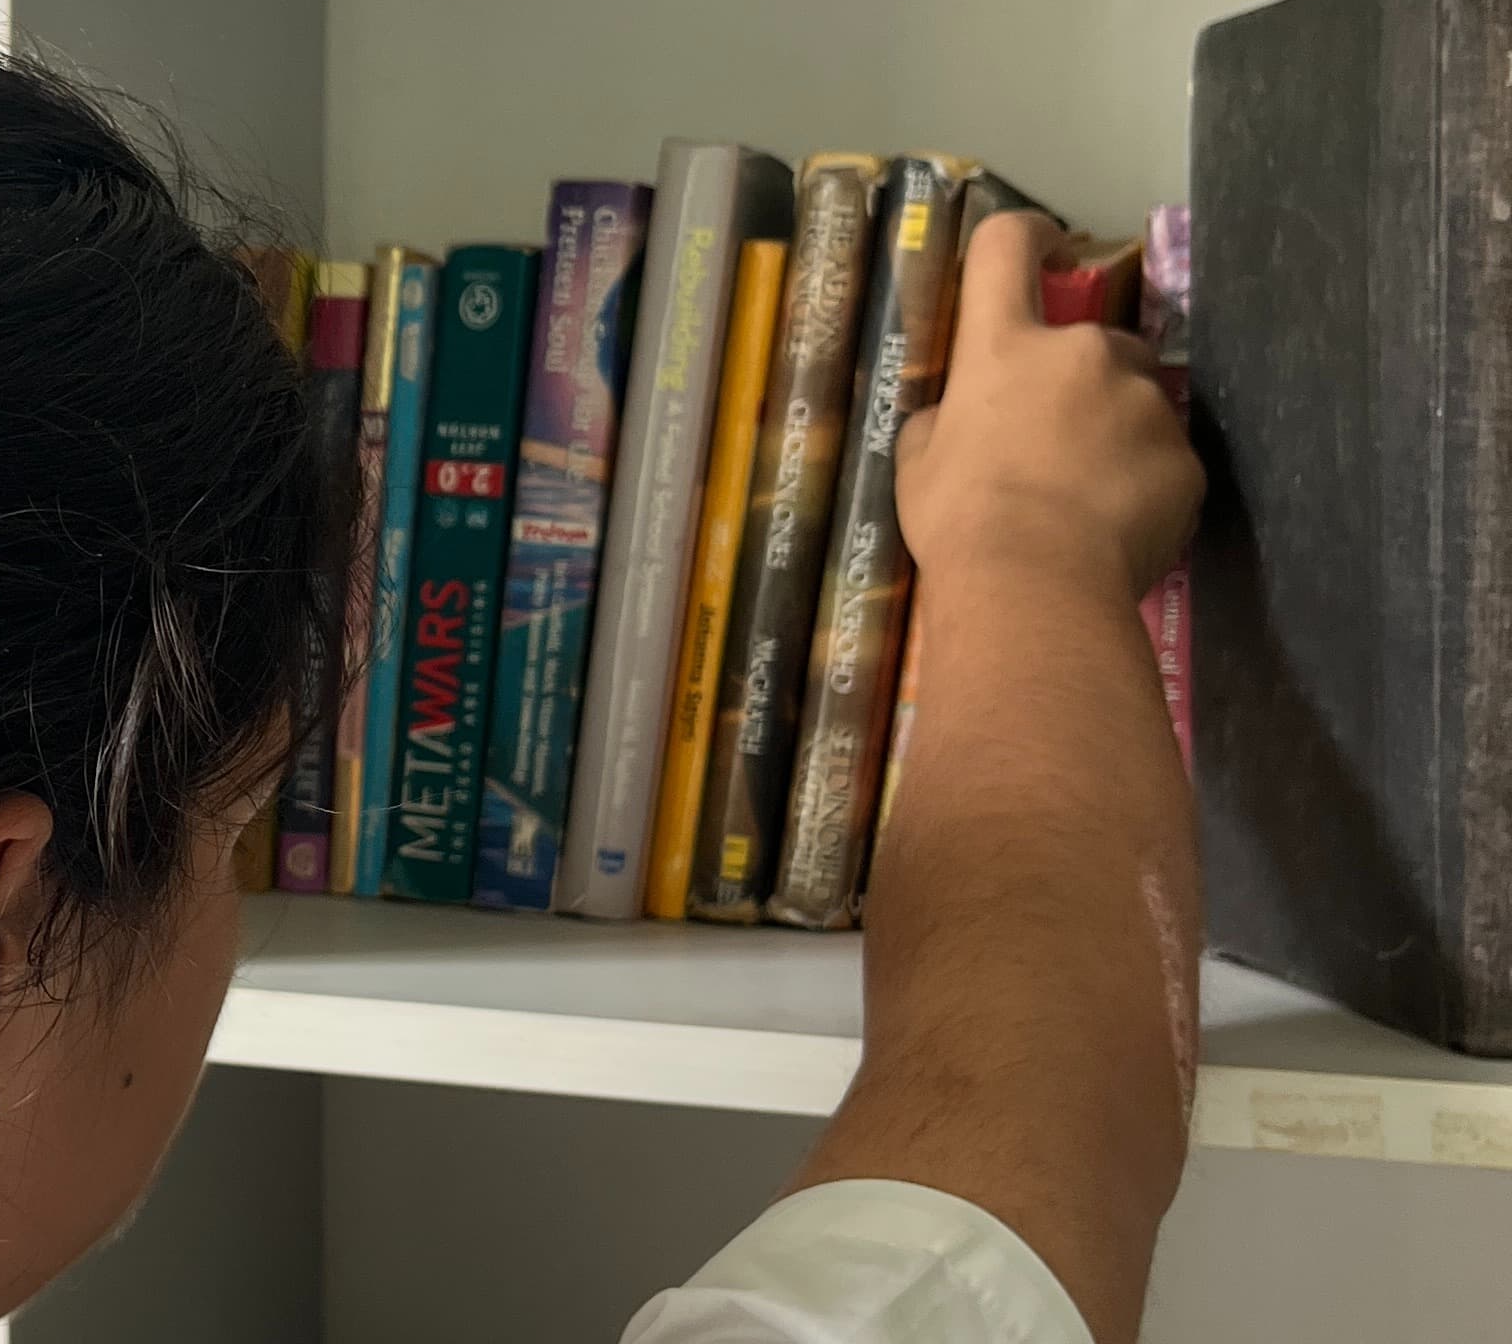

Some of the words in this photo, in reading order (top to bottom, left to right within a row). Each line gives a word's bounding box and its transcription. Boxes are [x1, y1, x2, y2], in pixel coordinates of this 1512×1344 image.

[553, 205, 585, 306] Preteen
[545, 313, 573, 374] Soul
[656, 227, 715, 392] Rebuilding
[867, 332, 909, 457] McGRATH
[775, 397, 811, 501] CHOSEN
[766, 501, 796, 569] ONES
[846, 520, 880, 590] ONES
[830, 589, 868, 696] CHOSEN
[397, 578, 470, 863] METAWARS
